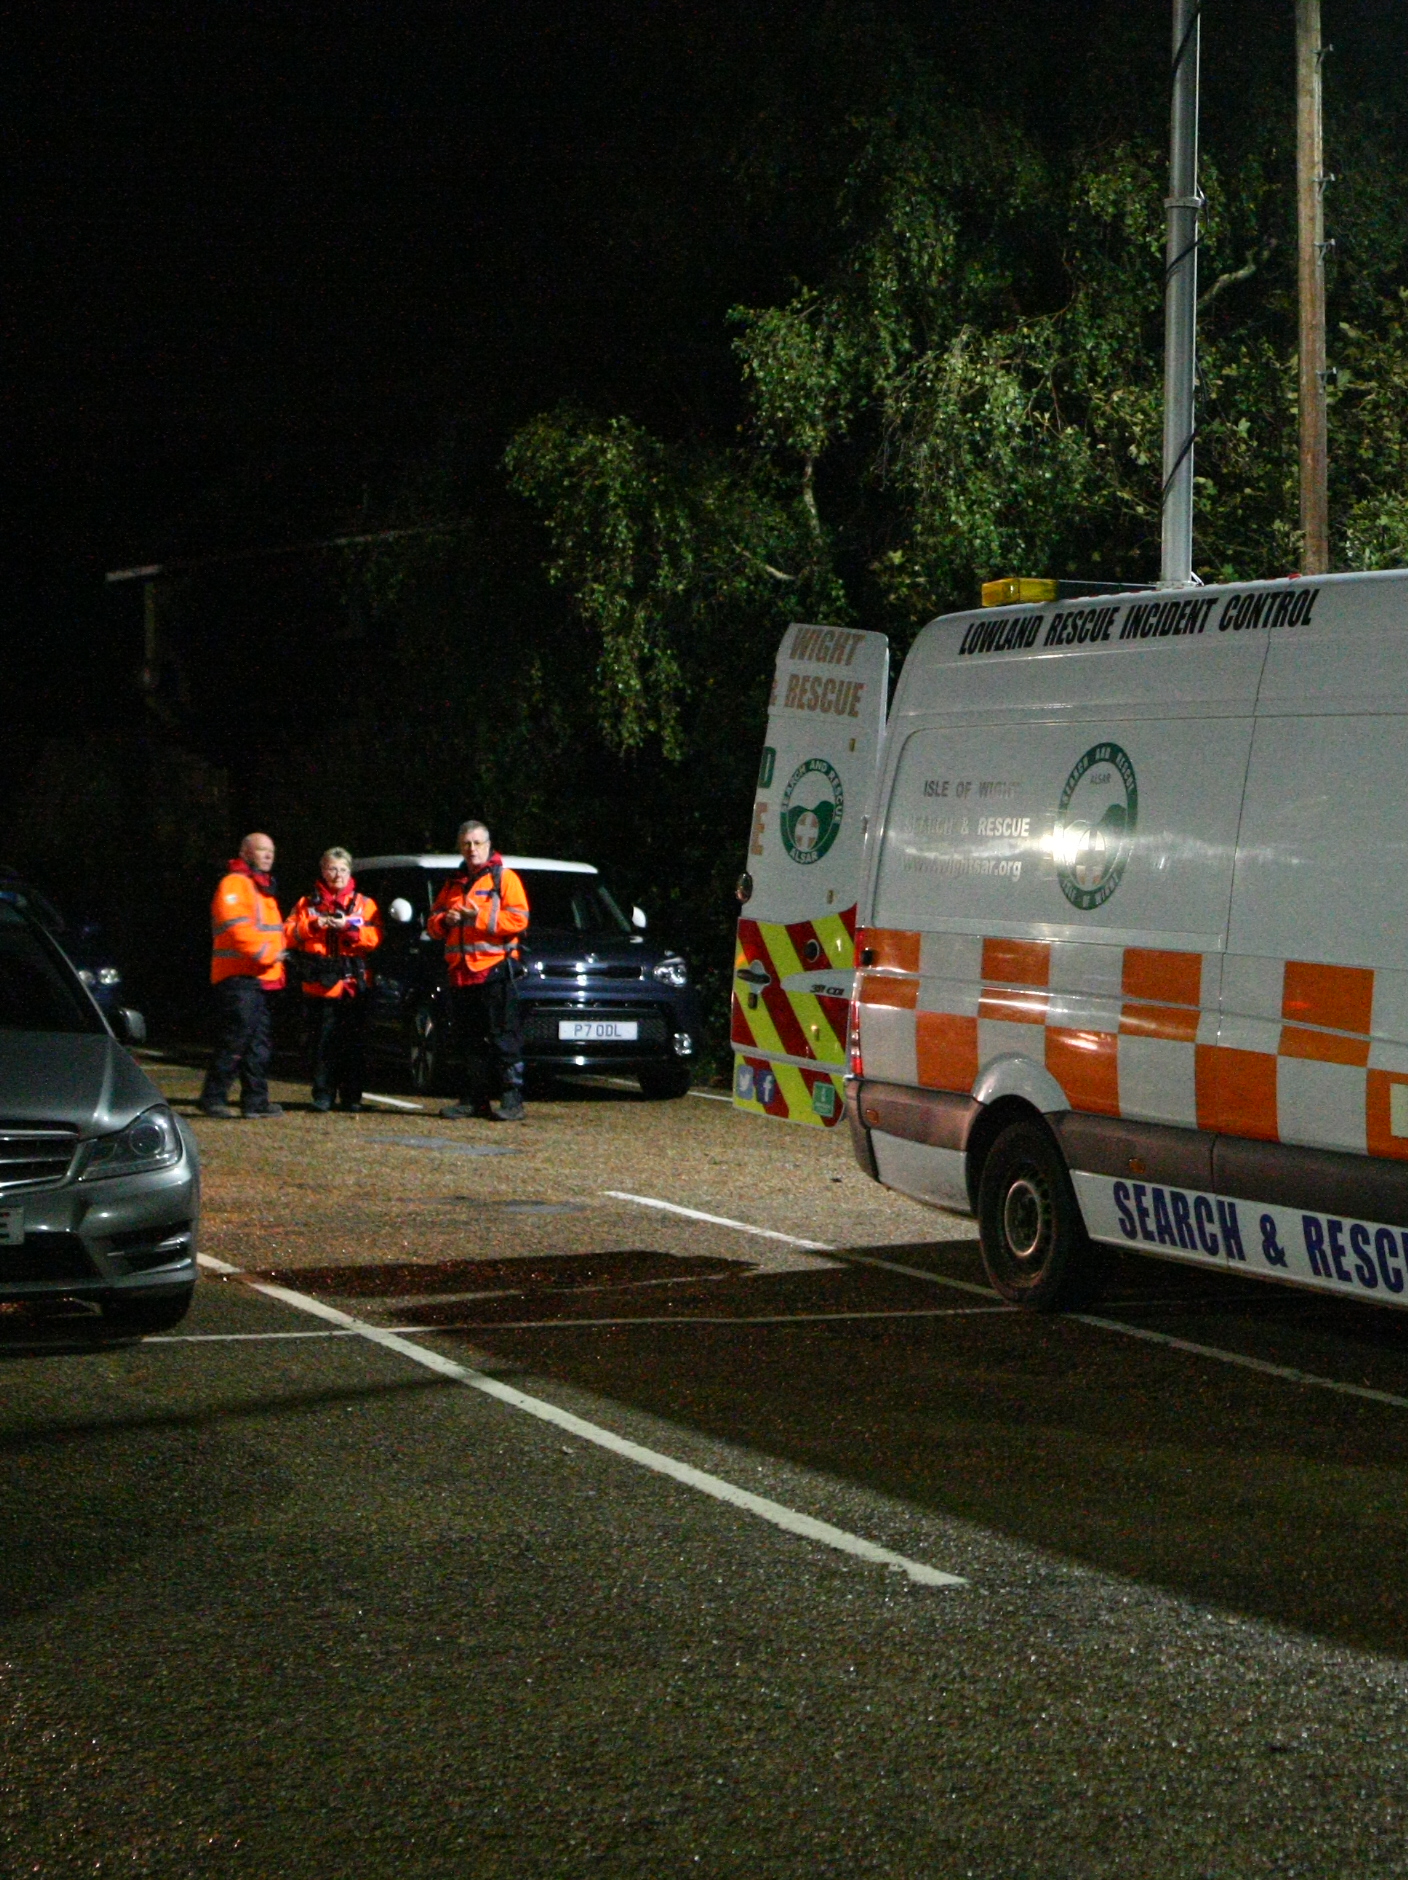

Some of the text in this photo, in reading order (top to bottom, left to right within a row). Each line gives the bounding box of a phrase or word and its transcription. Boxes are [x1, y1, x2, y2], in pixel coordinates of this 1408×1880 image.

[959, 588, 1320, 655] LOWLAND RESCUE INCIDENT CONTROL
[789, 627, 866, 666] WIGHT
[784, 673, 865, 718] RESCUE
[809, 759, 828, 772] AND
[923, 780, 950, 798] ISLE
[956, 781, 972, 798] OF
[977, 817, 1031, 837] RESCUE
[789, 848, 819, 864] ALSAR
[574, 1024, 622, 1037] P7 ODL
[1112, 1181, 1247, 1261] SEARCH
[1259, 1213, 1289, 1268] &
